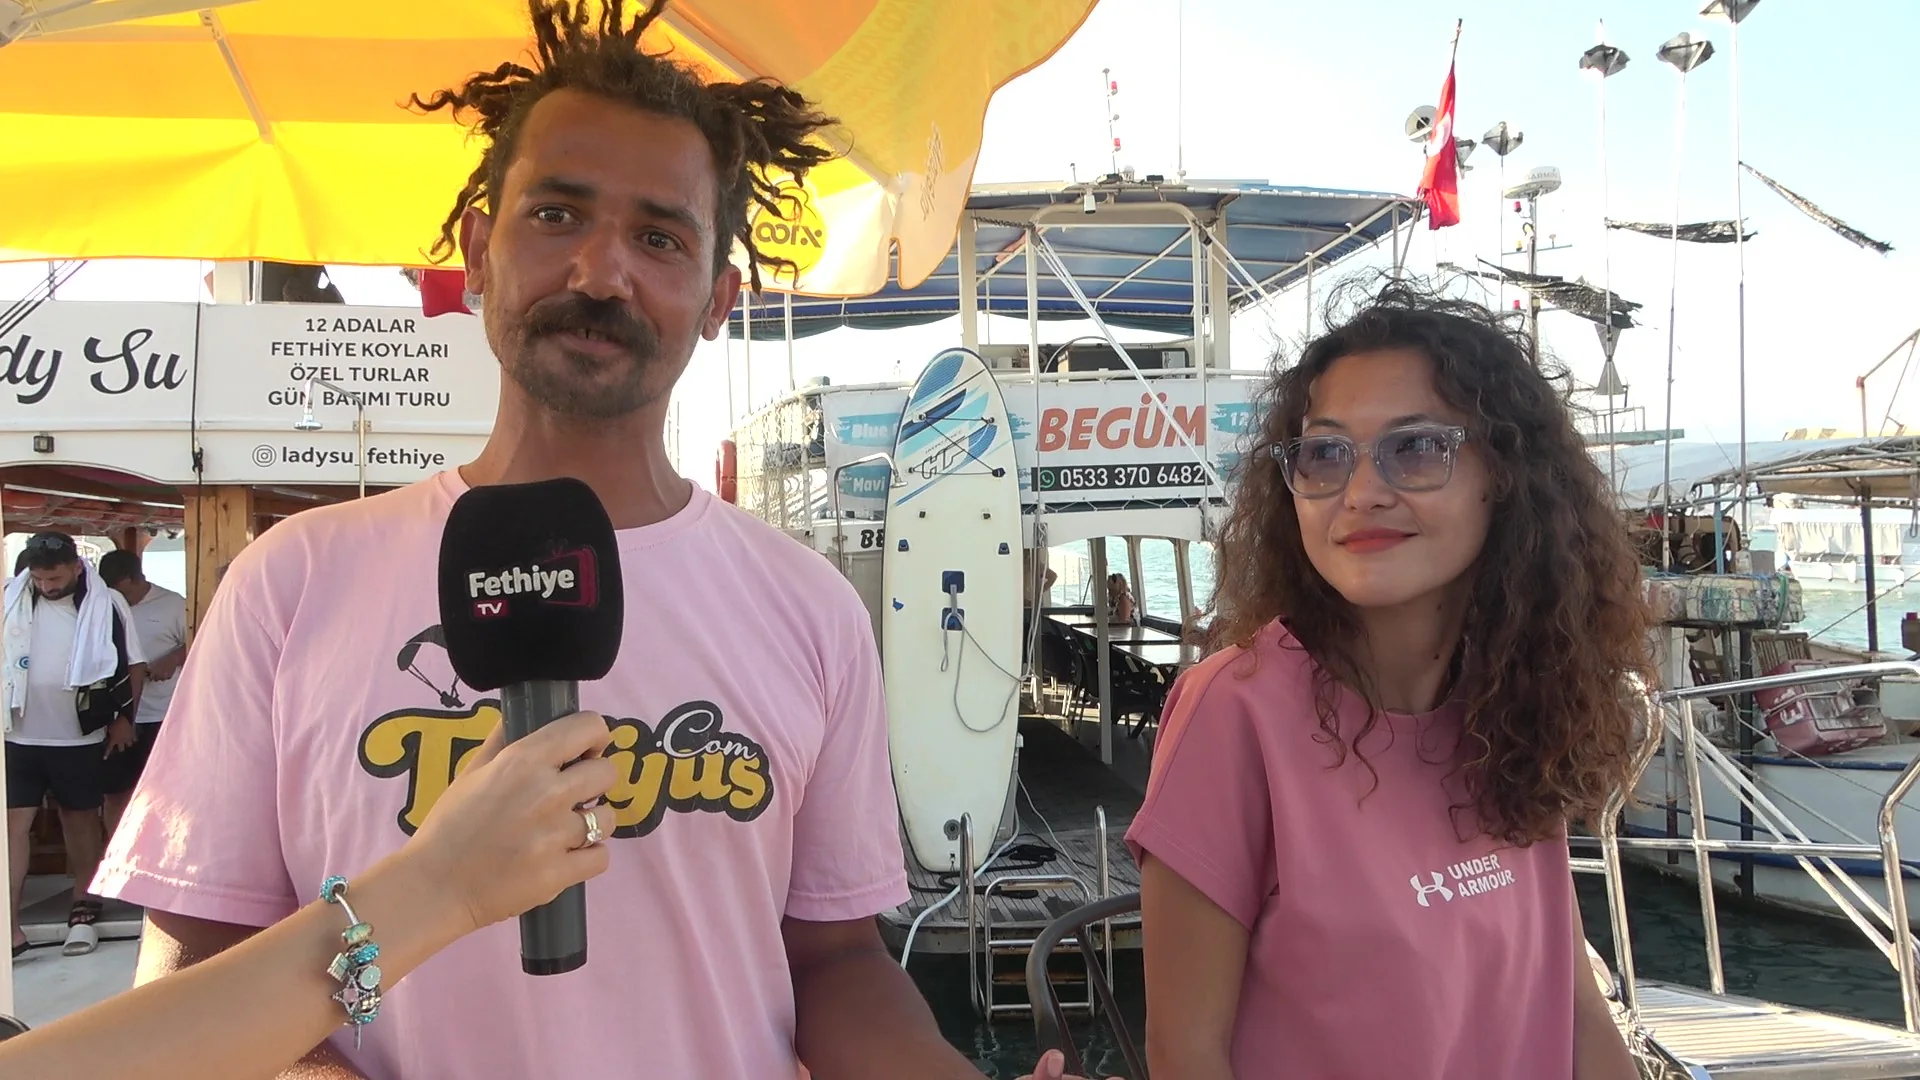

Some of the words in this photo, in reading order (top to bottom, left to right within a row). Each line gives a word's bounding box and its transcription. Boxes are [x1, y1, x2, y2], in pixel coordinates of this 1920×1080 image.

[305, 318, 328, 332] 12
[332, 318, 416, 334] ADALAR
[271, 338, 357, 357] FETHİYE
[361, 342, 449, 358] KOYLARI
[83, 328, 188, 395] Su
[290, 362, 344, 382] ÖZEL
[349, 367, 430, 382] TURLAR
[323, 391, 391, 406] BATIMI
[395, 392, 450, 406] TURU
[1036, 391, 1207, 453] BEGÜM
[853, 475, 886, 493] Mavi
[1059, 467, 1109, 489] 0533
[1114, 466, 1151, 486] 370
[1156, 464, 1205, 485] 6482
[468, 564, 575, 599] Fethiye
[477, 602, 503, 616] TV
[1447, 853, 1501, 880] UNDER
[1457, 869, 1516, 898] ARMOUR
